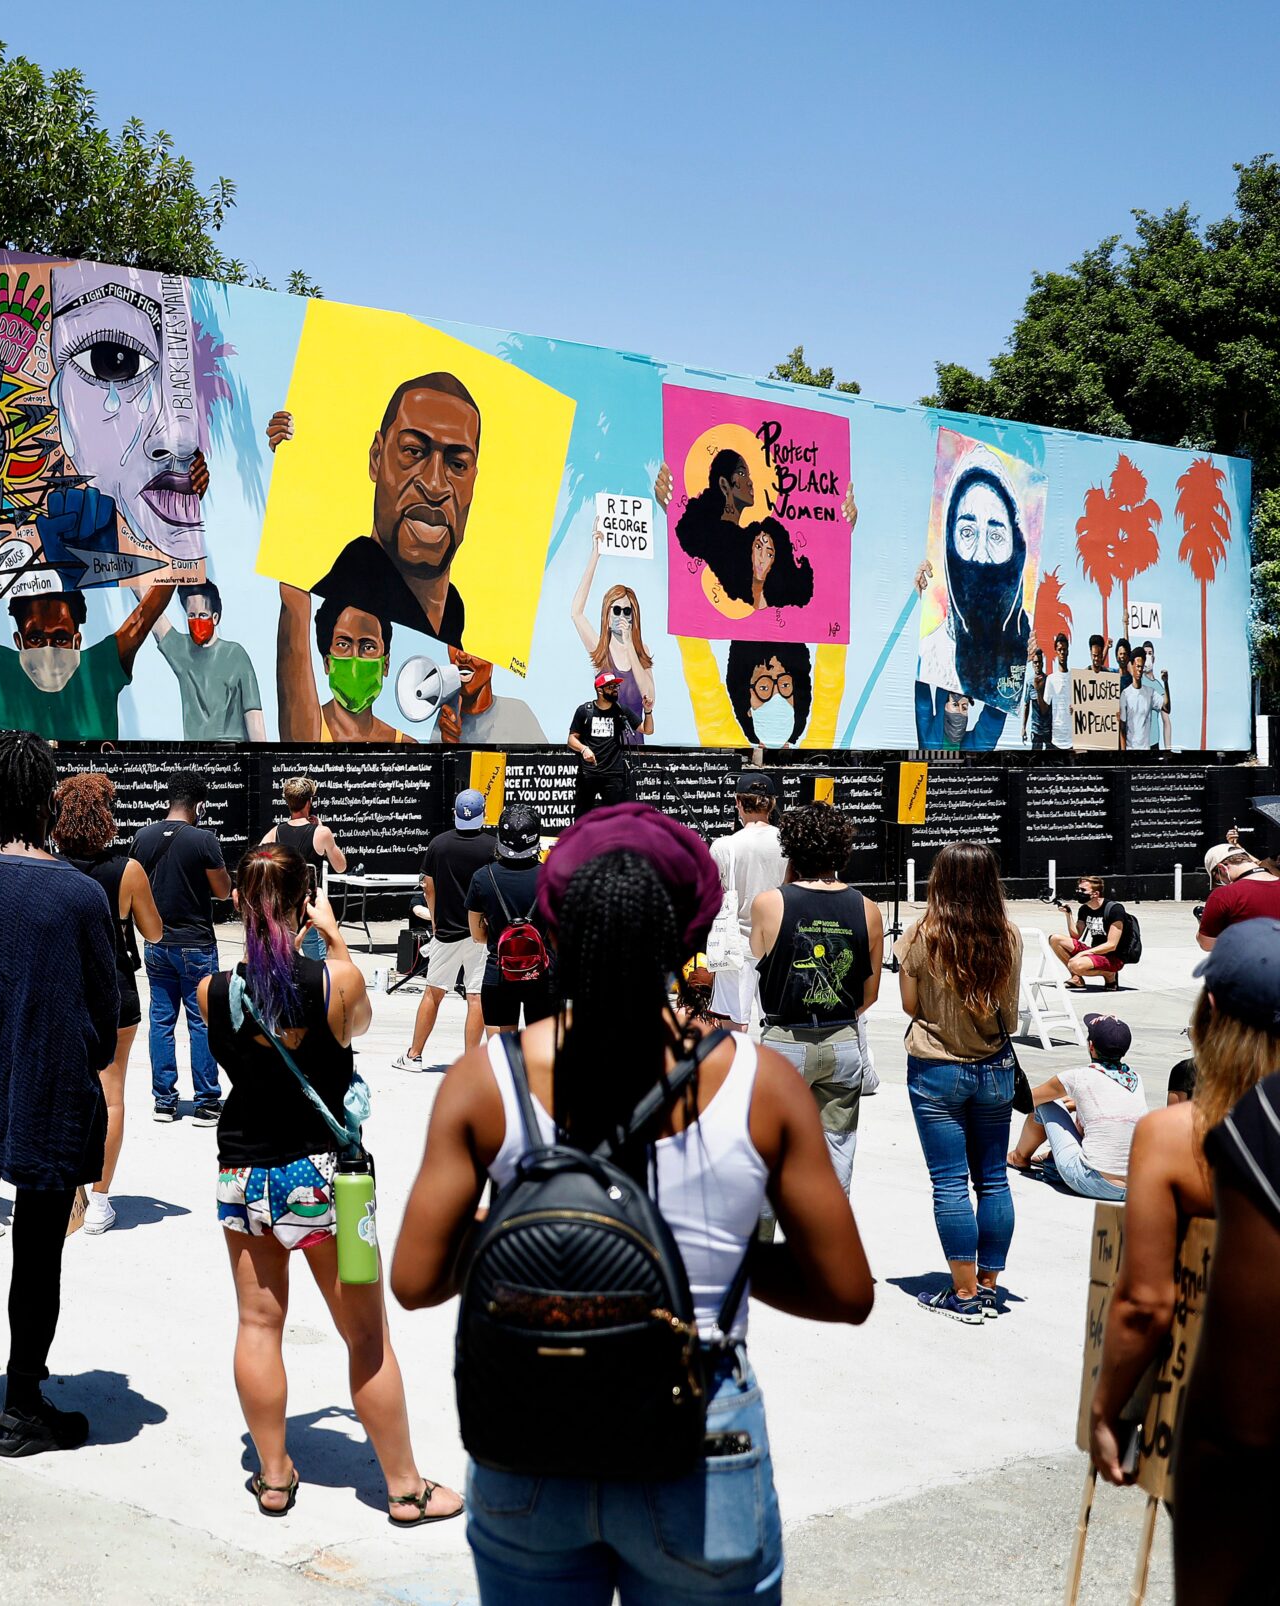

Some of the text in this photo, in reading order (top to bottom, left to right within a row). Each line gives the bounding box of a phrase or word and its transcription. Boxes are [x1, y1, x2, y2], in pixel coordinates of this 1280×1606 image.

[78, 283, 162, 327] FIGHT FIGHT FIGHT
[166, 321, 190, 360] LIVES
[169, 362, 194, 410] BLACK
[772, 464, 840, 496] BLACK
[606, 498, 642, 517] RIP
[16, 528, 35, 539] HOPE
[603, 517, 648, 534] GEORGE
[121, 525, 154, 552] Grievance
[606, 532, 648, 551] FLOYD
[4, 548, 26, 569] ABUSE
[93, 556, 135, 575] Brutality
[171, 558, 199, 570] EQUITY
[1131, 605, 1160, 629] BLM
[1073, 679, 1120, 705] NO JUSTICE
[1074, 710, 1118, 735] NO PEACE
[526, 766, 536, 776] IT.
[537, 765, 556, 776] YOU
[522, 778, 533, 788] IT.
[534, 778, 553, 788] YOU
[505, 790, 576, 801] IT. YOU DO EVER
[532, 805, 570, 816] OU TALK
